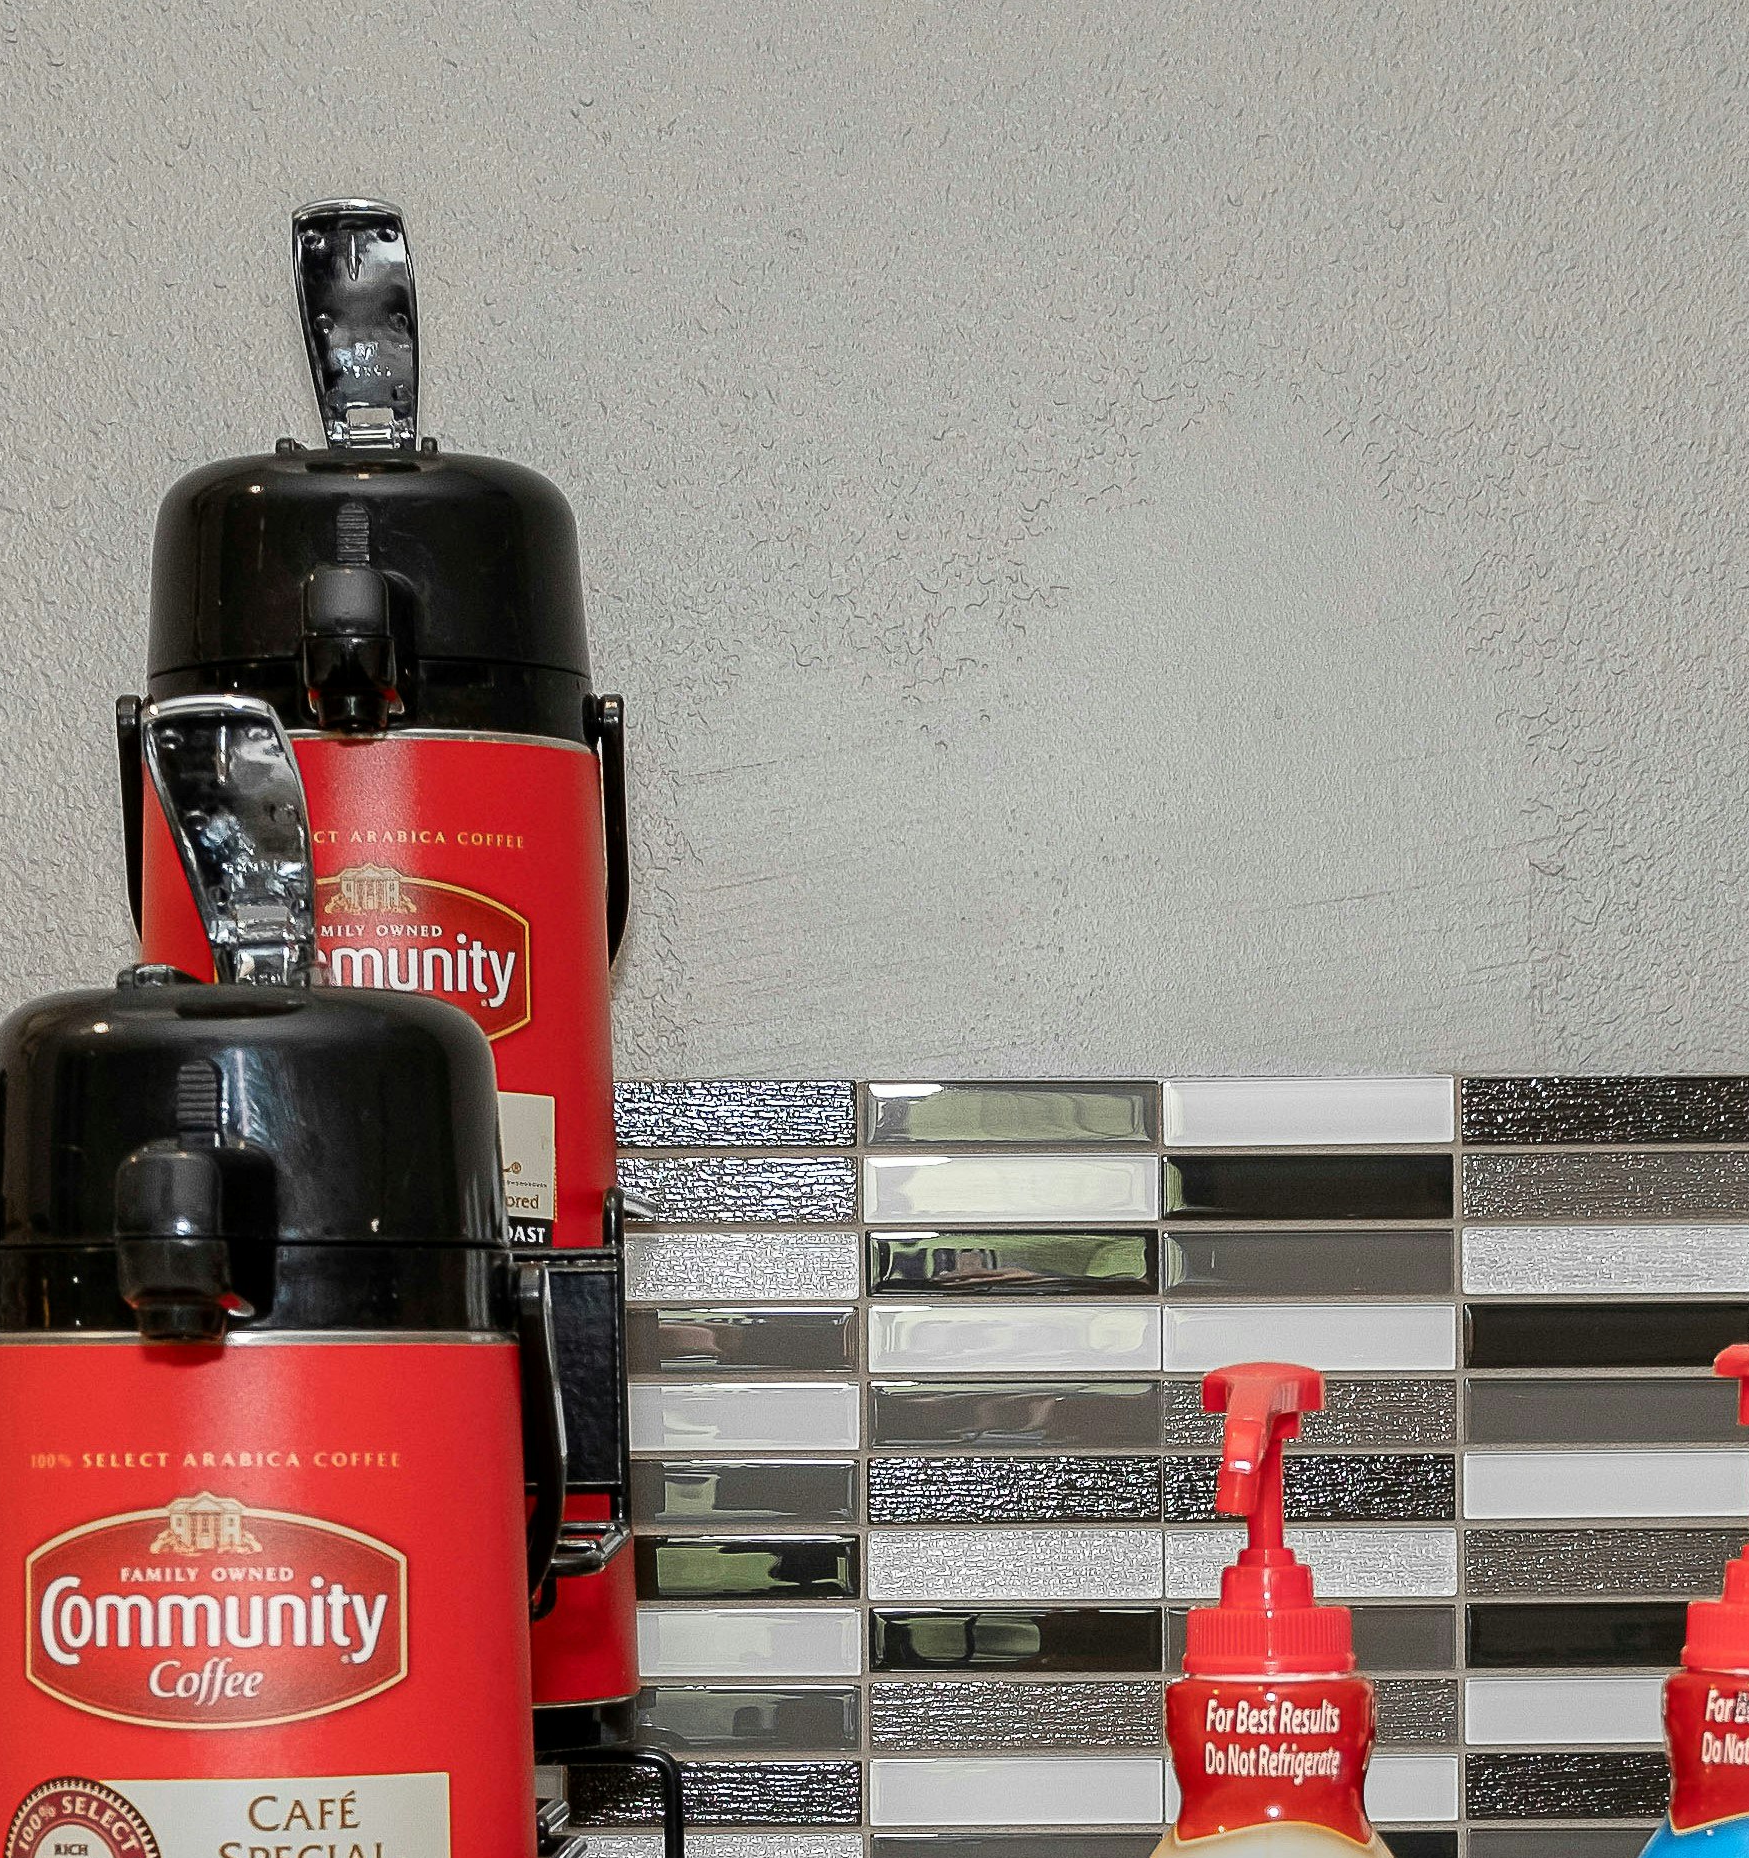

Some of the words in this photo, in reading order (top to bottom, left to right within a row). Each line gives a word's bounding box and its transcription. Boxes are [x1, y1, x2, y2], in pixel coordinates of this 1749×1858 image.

[350, 830, 445, 844] ARABICA
[457, 832, 524, 848] COFFEE
[320, 925, 365, 937] MILY
[376, 924, 443, 937] OWNED
[317, 933, 516, 1008] munity
[509, 1226, 545, 1243] AST
[83, 1453, 168, 1468] SELECT
[183, 1452, 300, 1468] ARABICA
[313, 1452, 400, 1468] COFFEE
[120, 1567, 199, 1582] FAMILY
[211, 1566, 294, 1582] OWNED
[40, 1576, 387, 1665] Community
[149, 1657, 264, 1705] Coffee
[1206, 1699, 1235, 1733] For
[1236, 1700, 1276, 1734] Best
[1279, 1699, 1340, 1734] Results
[1705, 1689, 1734, 1722] For
[1205, 1741, 1224, 1775] Do
[1228, 1743, 1256, 1776] Not
[1259, 1742, 1340, 1786] Refrigerate
[1702, 1731, 1722, 1764] Do
[18, 1803, 56, 1851] 100%
[61, 1796, 136, 1851] SELECT
[248, 1791, 359, 1832] CAFÉ
[54, 1844, 88, 1856] RICH
